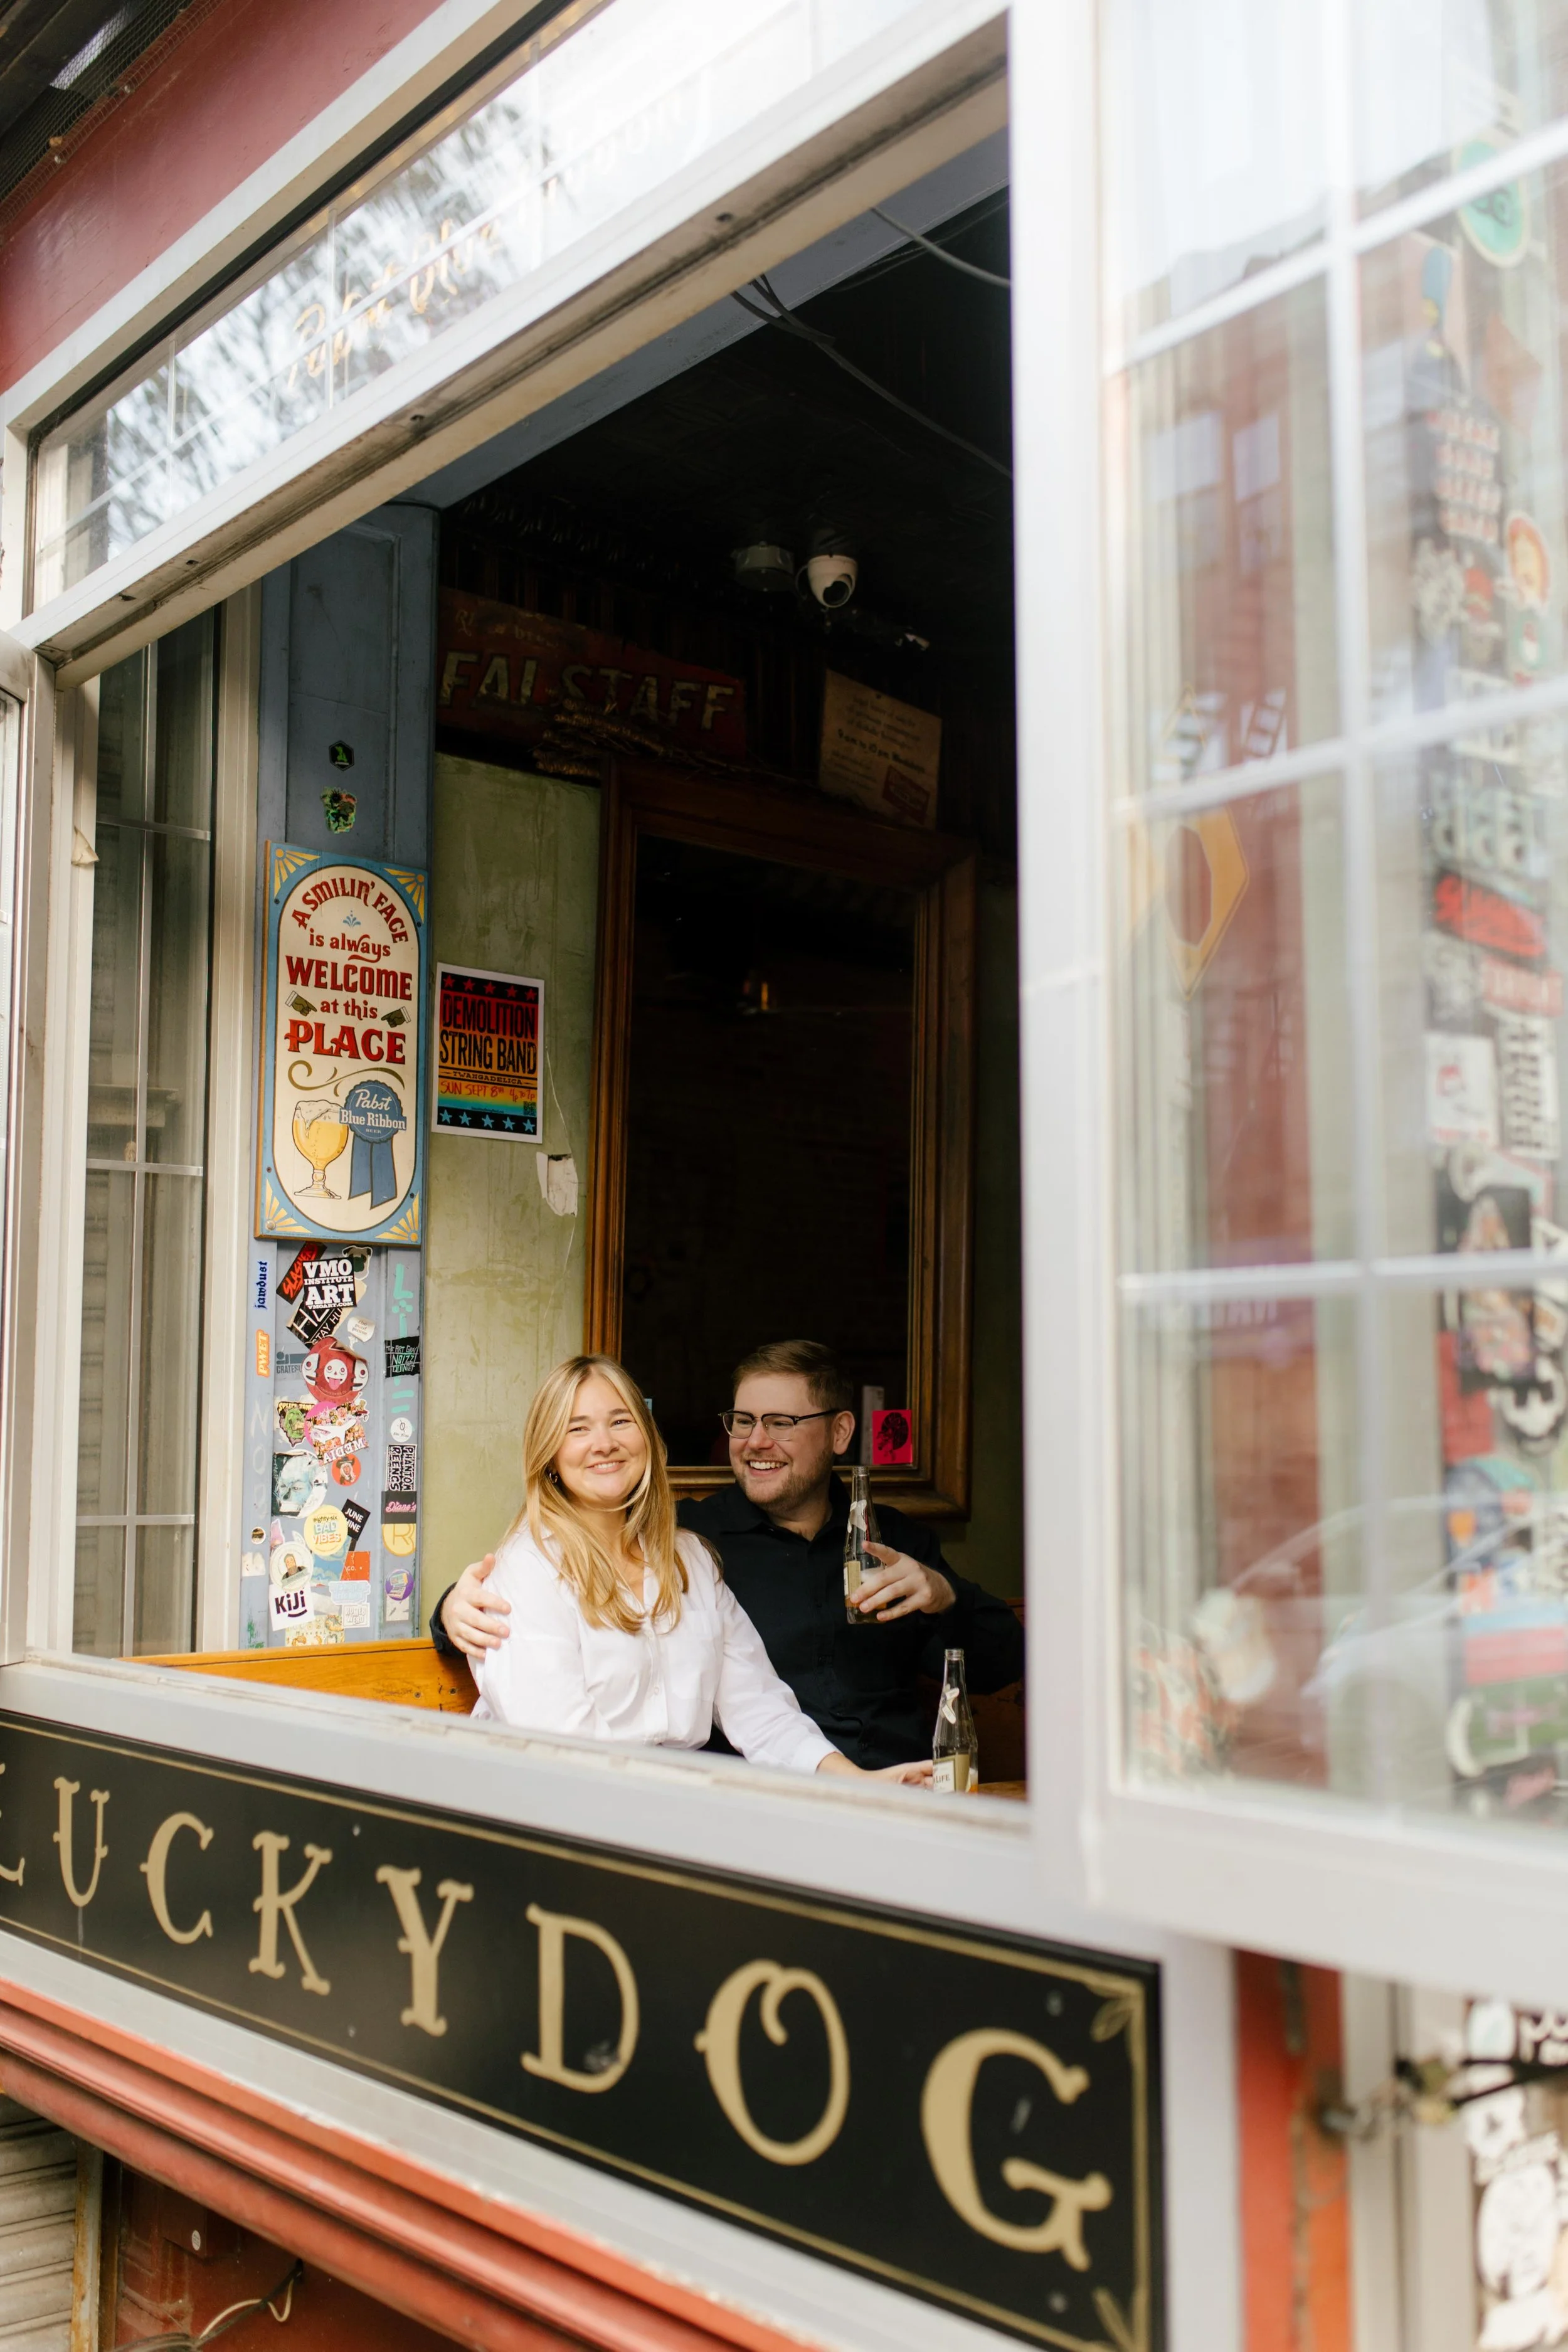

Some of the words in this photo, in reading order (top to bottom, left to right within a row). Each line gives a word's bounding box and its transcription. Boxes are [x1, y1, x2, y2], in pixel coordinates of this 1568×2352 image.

[291, 909, 312, 930] A
[302, 877, 376, 911] SMILIN'
[371, 891, 409, 944] FACE
[309, 928, 324, 947] is
[329, 933, 391, 963] always
[285, 955, 413, 1000] WELCOME
[320, 999, 339, 1014] at
[343, 998, 378, 1020] this
[442, 993, 536, 1040] DEMOLITION
[284, 1019, 406, 1065] PLACE
[440, 1029, 493, 1069] STRING
[497, 1037, 537, 1075] BAND
[453, 1071, 522, 1084] TWANGADELICA
[355, 1089, 392, 1110] Pabst
[440, 1081, 462, 1094] SUN
[465, 1084, 487, 1097] SEPT
[341, 1109, 366, 1125] Blue
[366, 1112, 406, 1130] Ribbon
[303, 1259, 352, 1278] VMO
[304, 1275, 354, 1285] INSTITUTE
[305, 1283, 354, 1306] ART
[307, 1301, 354, 1310] VMOART.COM
[403, 1446, 414, 1491] PHANTOM
[345, 1508, 364, 1523] JUNE
[386, 1501, 416, 1512] Diane's
[314, 1521, 337, 1535] BAD
[346, 1518, 361, 1533] HINE
[312, 1533, 342, 1545] VIBES
